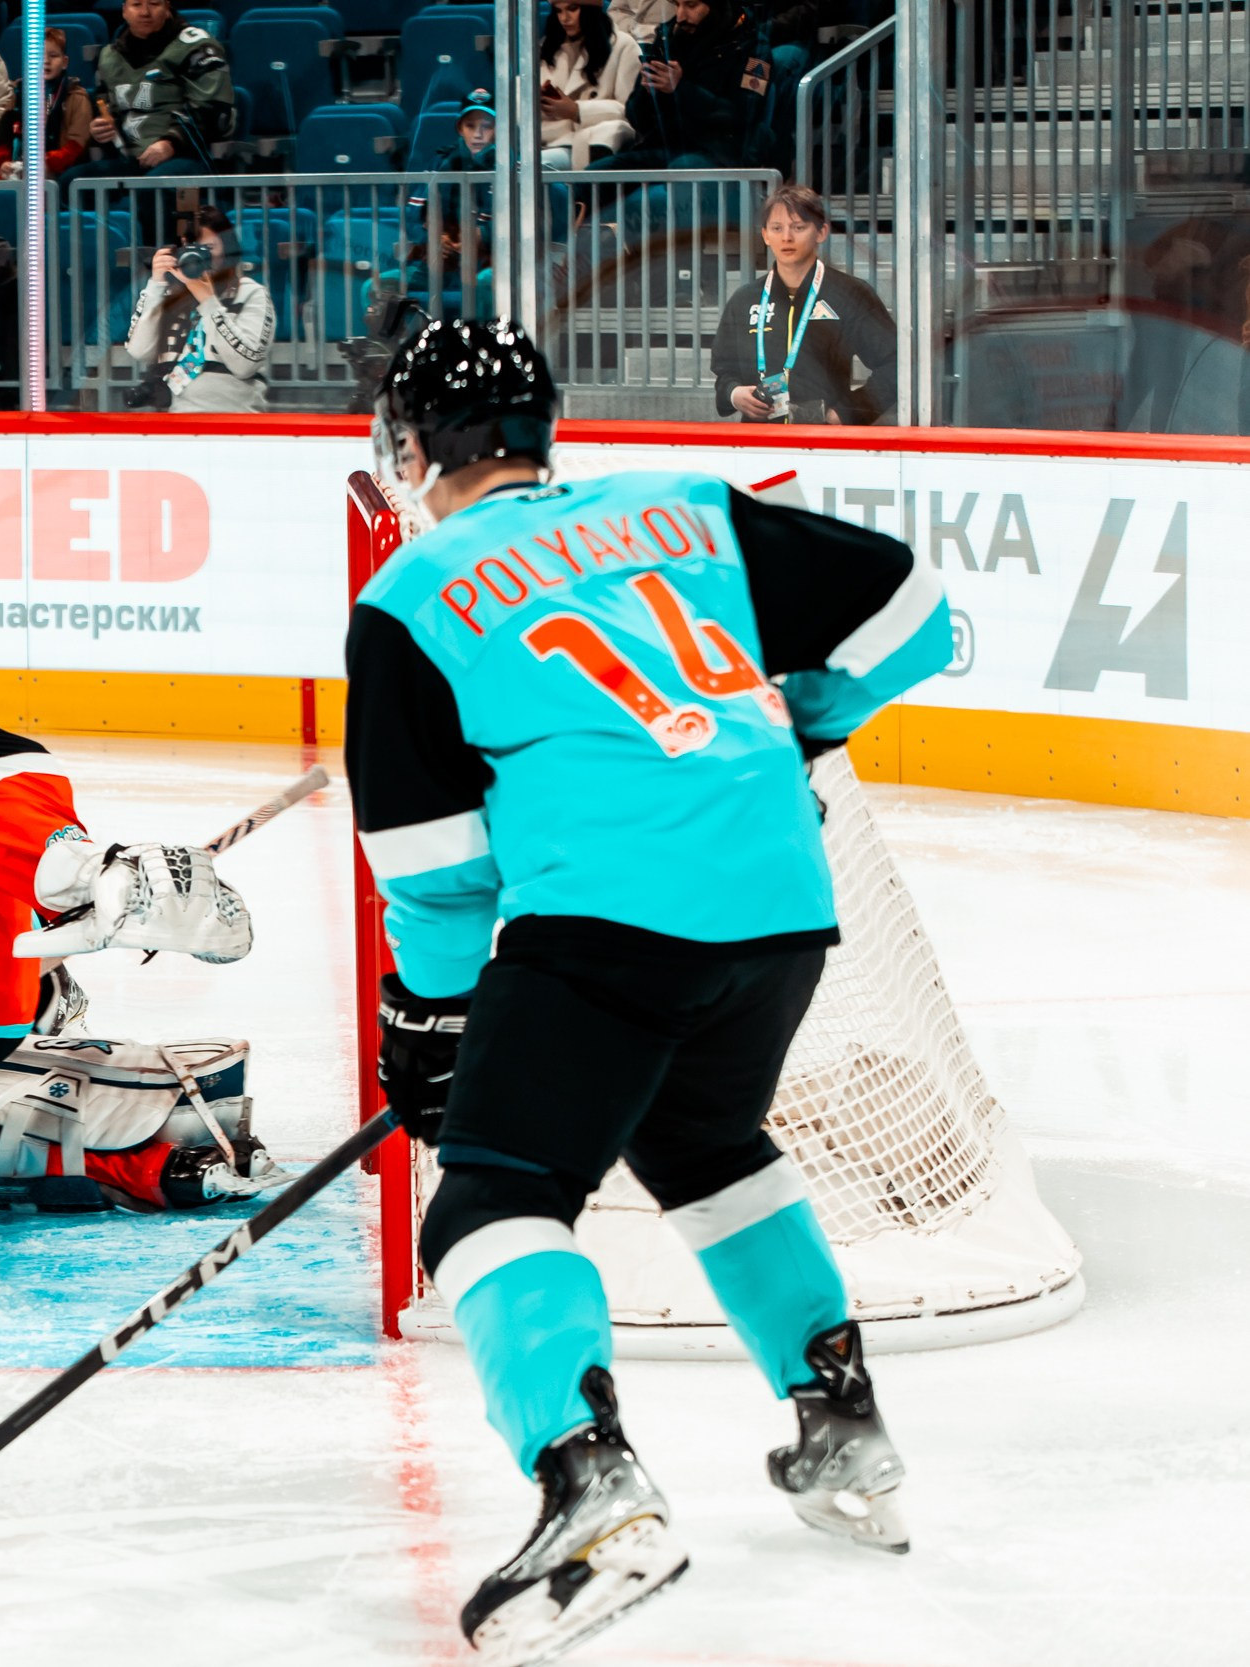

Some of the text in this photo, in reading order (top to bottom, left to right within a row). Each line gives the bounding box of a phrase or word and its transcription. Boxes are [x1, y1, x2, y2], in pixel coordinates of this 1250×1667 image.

[439, 506, 717, 637] POLYAKOV
[822, 486, 1041, 574] TIKA
[519, 570, 791, 759] 14
[99, 1221, 253, 1363] CCM
